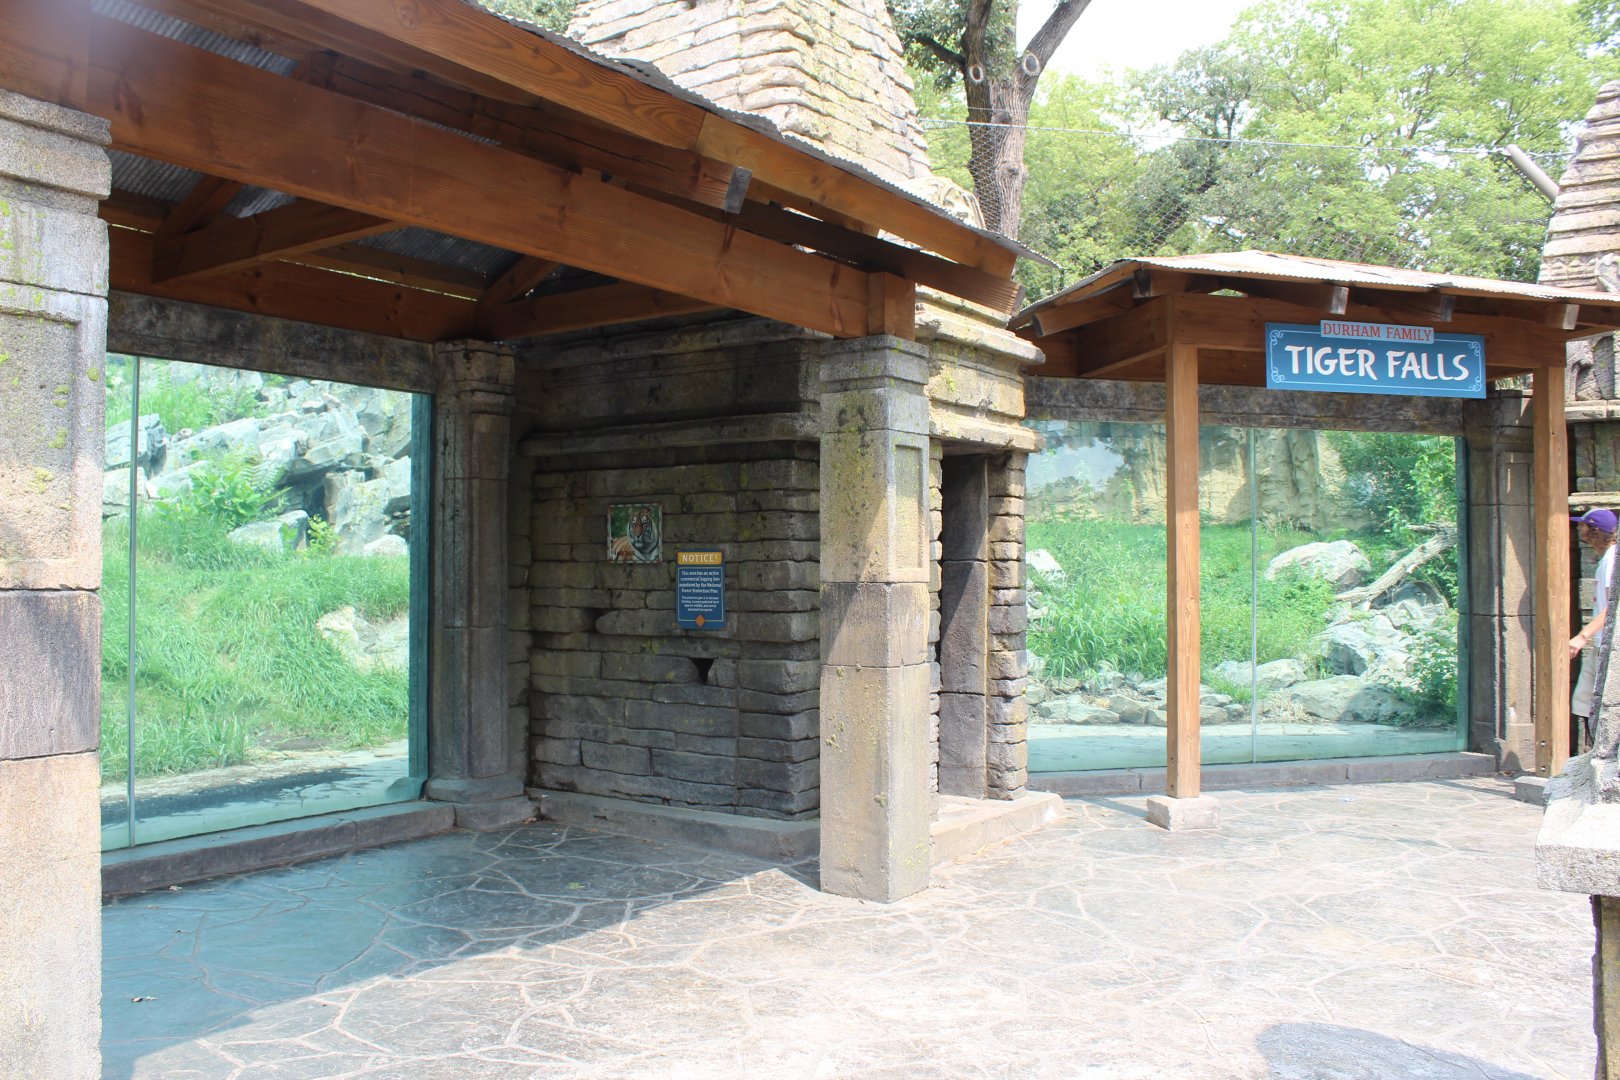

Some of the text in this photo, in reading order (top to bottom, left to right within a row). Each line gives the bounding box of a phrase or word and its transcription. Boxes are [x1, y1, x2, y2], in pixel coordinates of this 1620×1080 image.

[1323, 323, 1432, 341] DURHAM FAMILY
[1284, 345, 1469, 381] TIGER FALLS
[682, 554, 718, 563] NOTICE!
